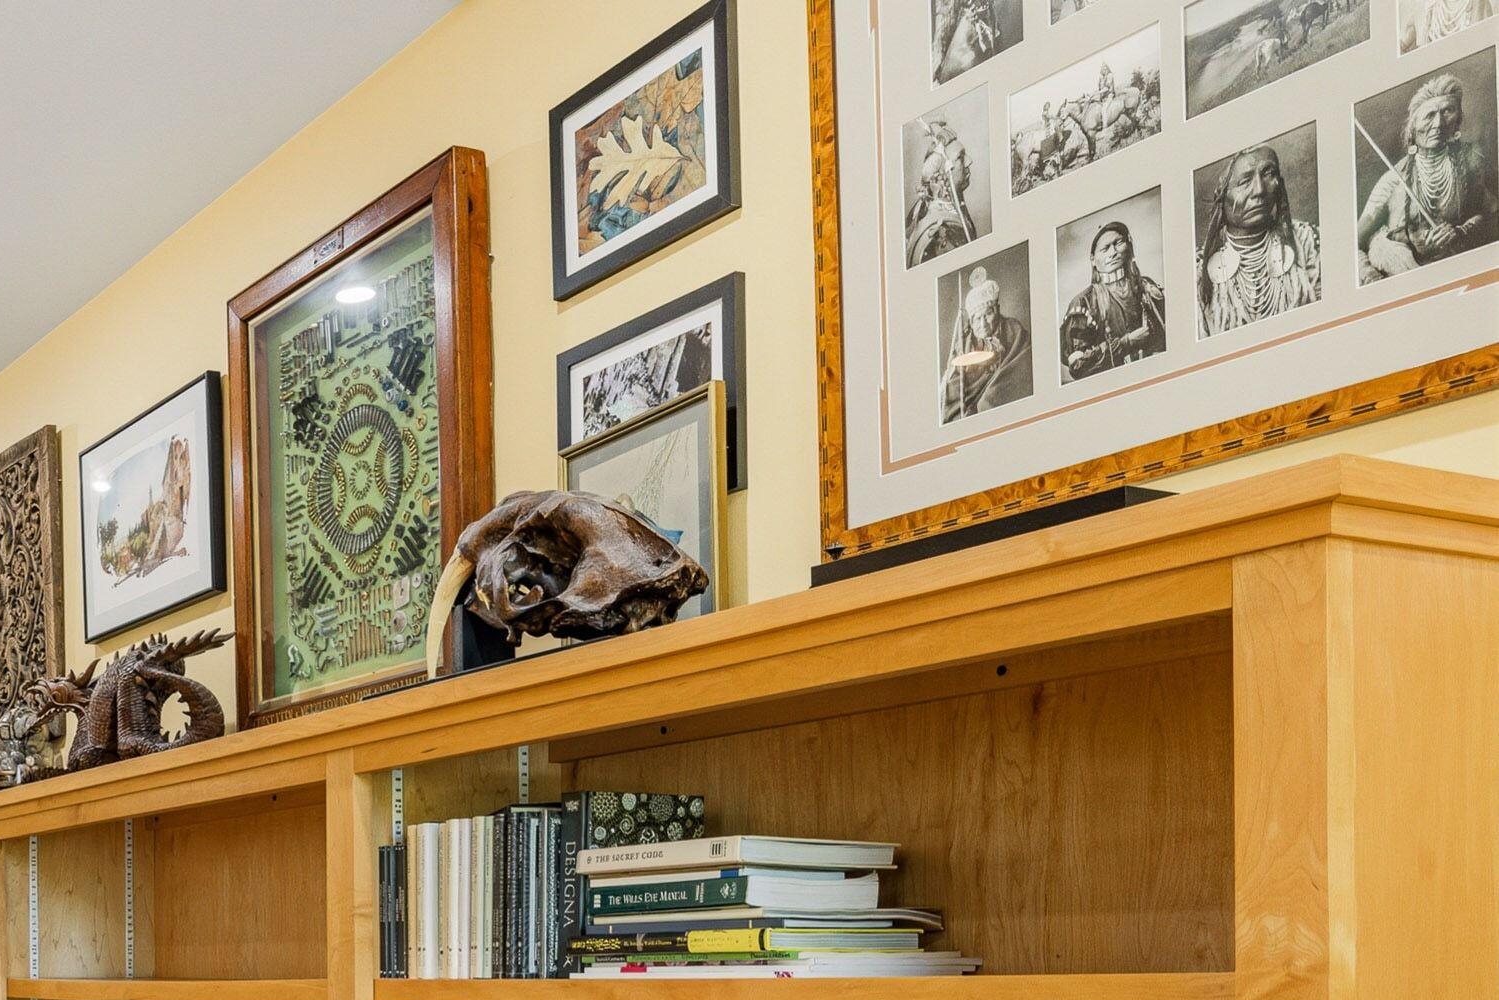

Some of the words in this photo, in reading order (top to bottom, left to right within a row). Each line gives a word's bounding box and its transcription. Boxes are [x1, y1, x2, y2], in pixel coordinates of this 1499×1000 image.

[596, 855, 609, 863] THE
[612, 852, 639, 862] SECRET
[641, 850, 664, 860] CODE
[563, 841, 576, 928] DESIGNA
